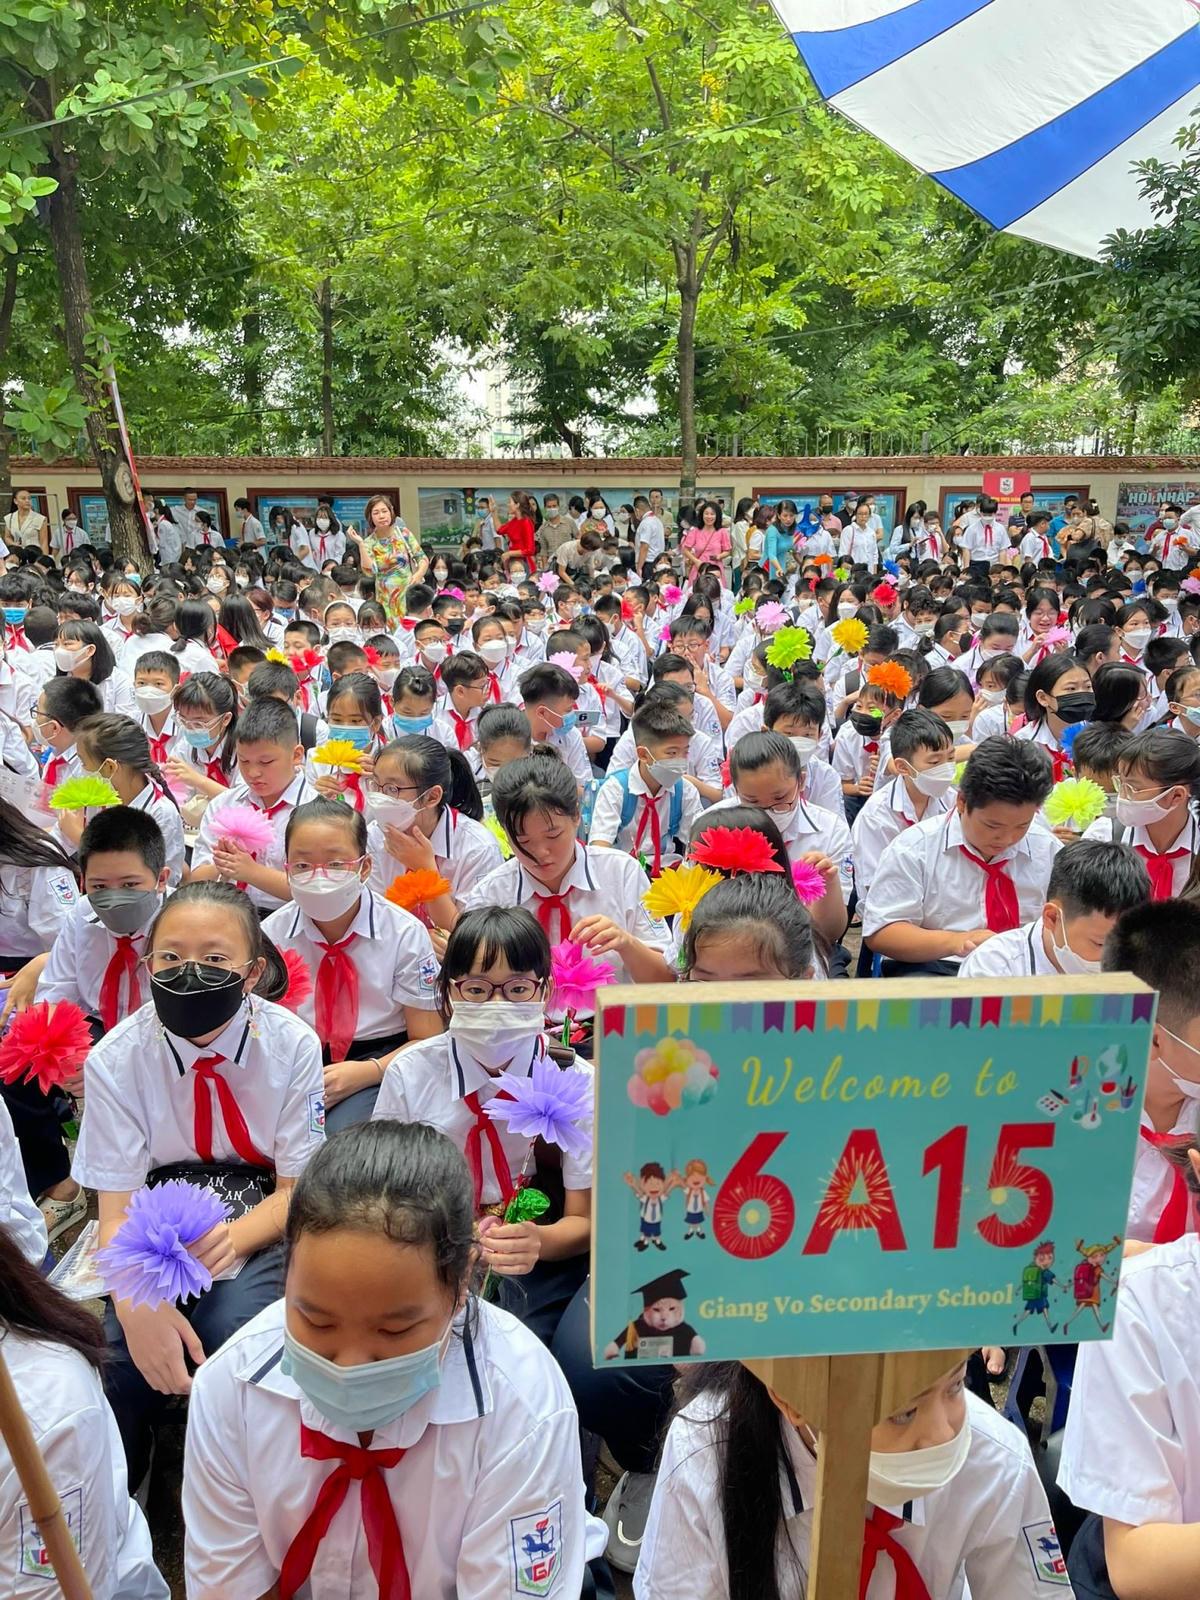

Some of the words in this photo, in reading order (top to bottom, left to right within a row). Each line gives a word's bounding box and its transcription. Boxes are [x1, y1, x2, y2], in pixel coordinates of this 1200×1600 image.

[578, 713, 588, 721] 6
[742, 1054, 952, 1107] Welcome
[974, 1057, 1019, 1098] to
[712, 1122, 1057, 1260] 6A15
[699, 1298, 769, 1323] Giang
[774, 1294, 806, 1316] Vo
[810, 1288, 932, 1319] Secondary
[936, 1284, 1014, 1309] School
